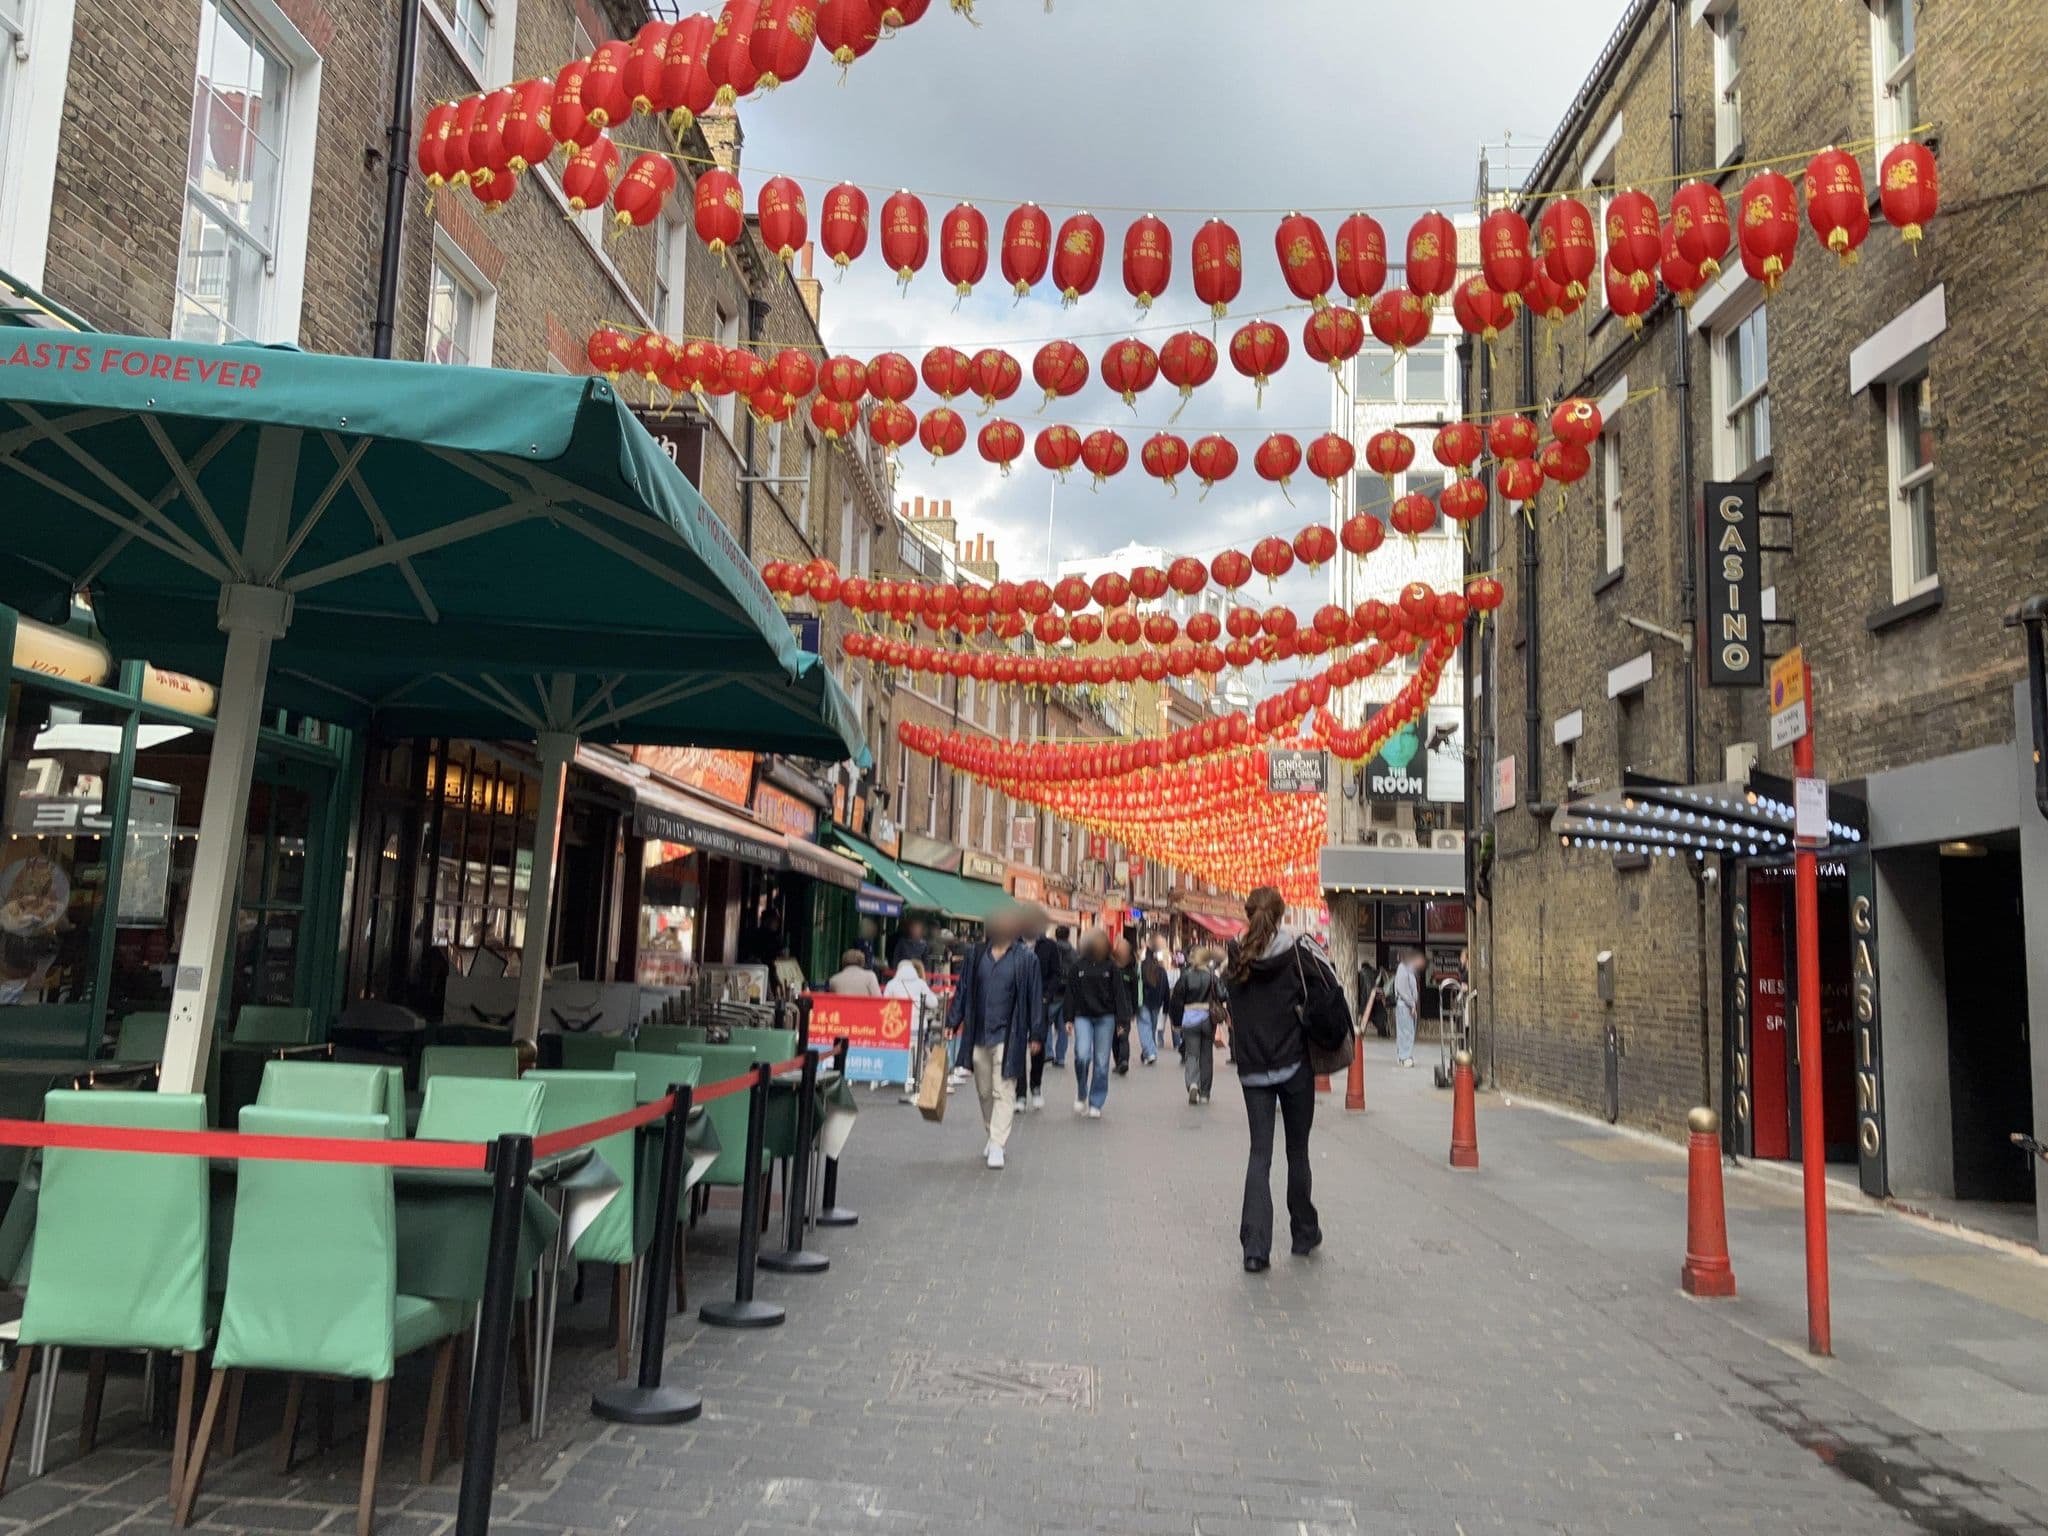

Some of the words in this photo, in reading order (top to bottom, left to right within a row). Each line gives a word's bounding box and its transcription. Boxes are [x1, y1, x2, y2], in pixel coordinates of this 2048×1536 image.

[101, 349, 262, 389] FOREVER
[1719, 495, 1750, 672] CASINO
[1273, 759, 1320, 770] LONDON'S
[1372, 776, 1423, 795] ROOM
[851, 1025, 877, 1037] Buffet
[1732, 902, 1750, 1122] CASINO
[1851, 895, 1881, 1159] CASINO
